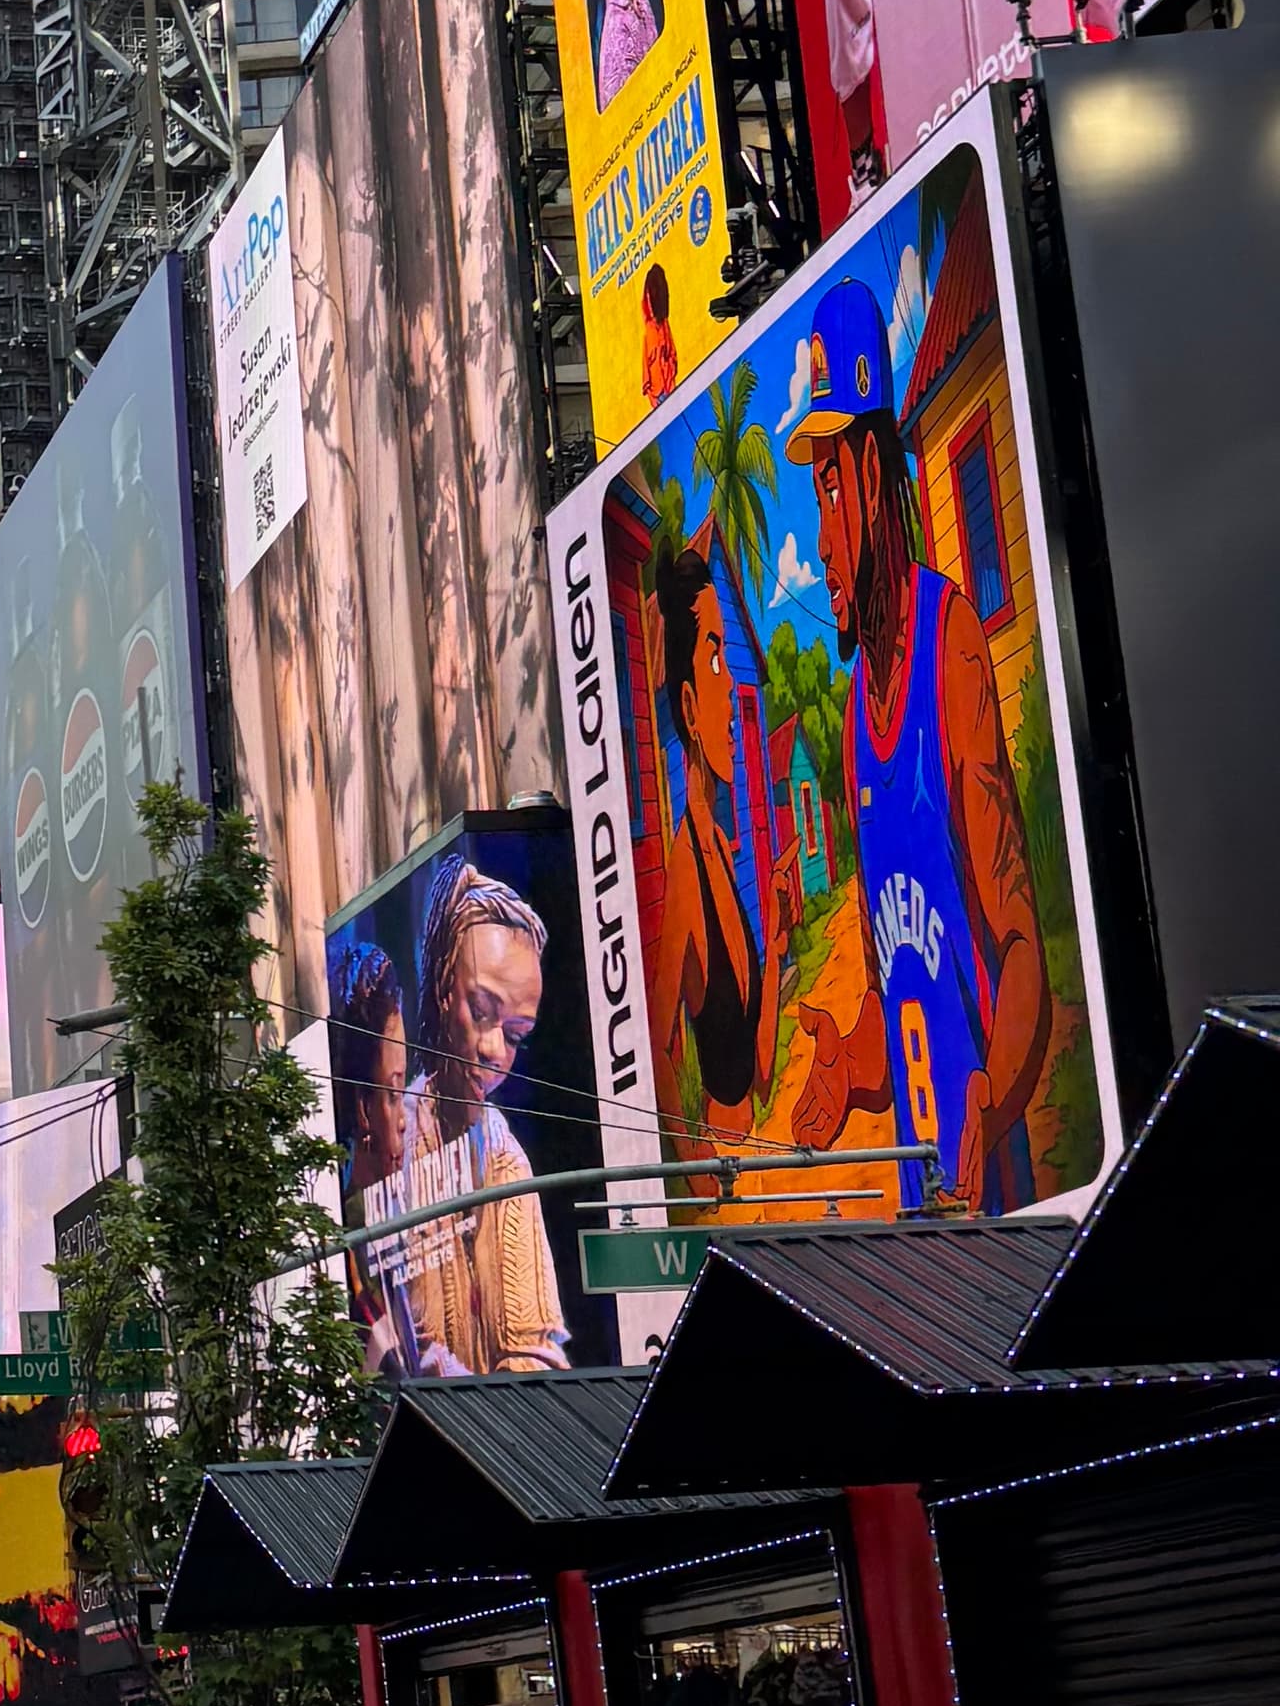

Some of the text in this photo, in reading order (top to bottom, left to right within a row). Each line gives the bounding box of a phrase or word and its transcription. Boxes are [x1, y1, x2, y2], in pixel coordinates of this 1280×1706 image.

[635, 73, 707, 219] KITCHEN
[219, 195, 285, 327] ArtPop
[617, 201, 684, 290] ALICIA KEYS
[220, 260, 275, 349] STREET GALLERY
[240, 324, 273, 385] Susan
[62, 745, 105, 826] BURGERS
[17, 818, 50, 878] WINGS
[900, 998, 939, 1142] 8
[653, 1241, 688, 1275] W
[5, 1357, 60, 1383] Lloyd
